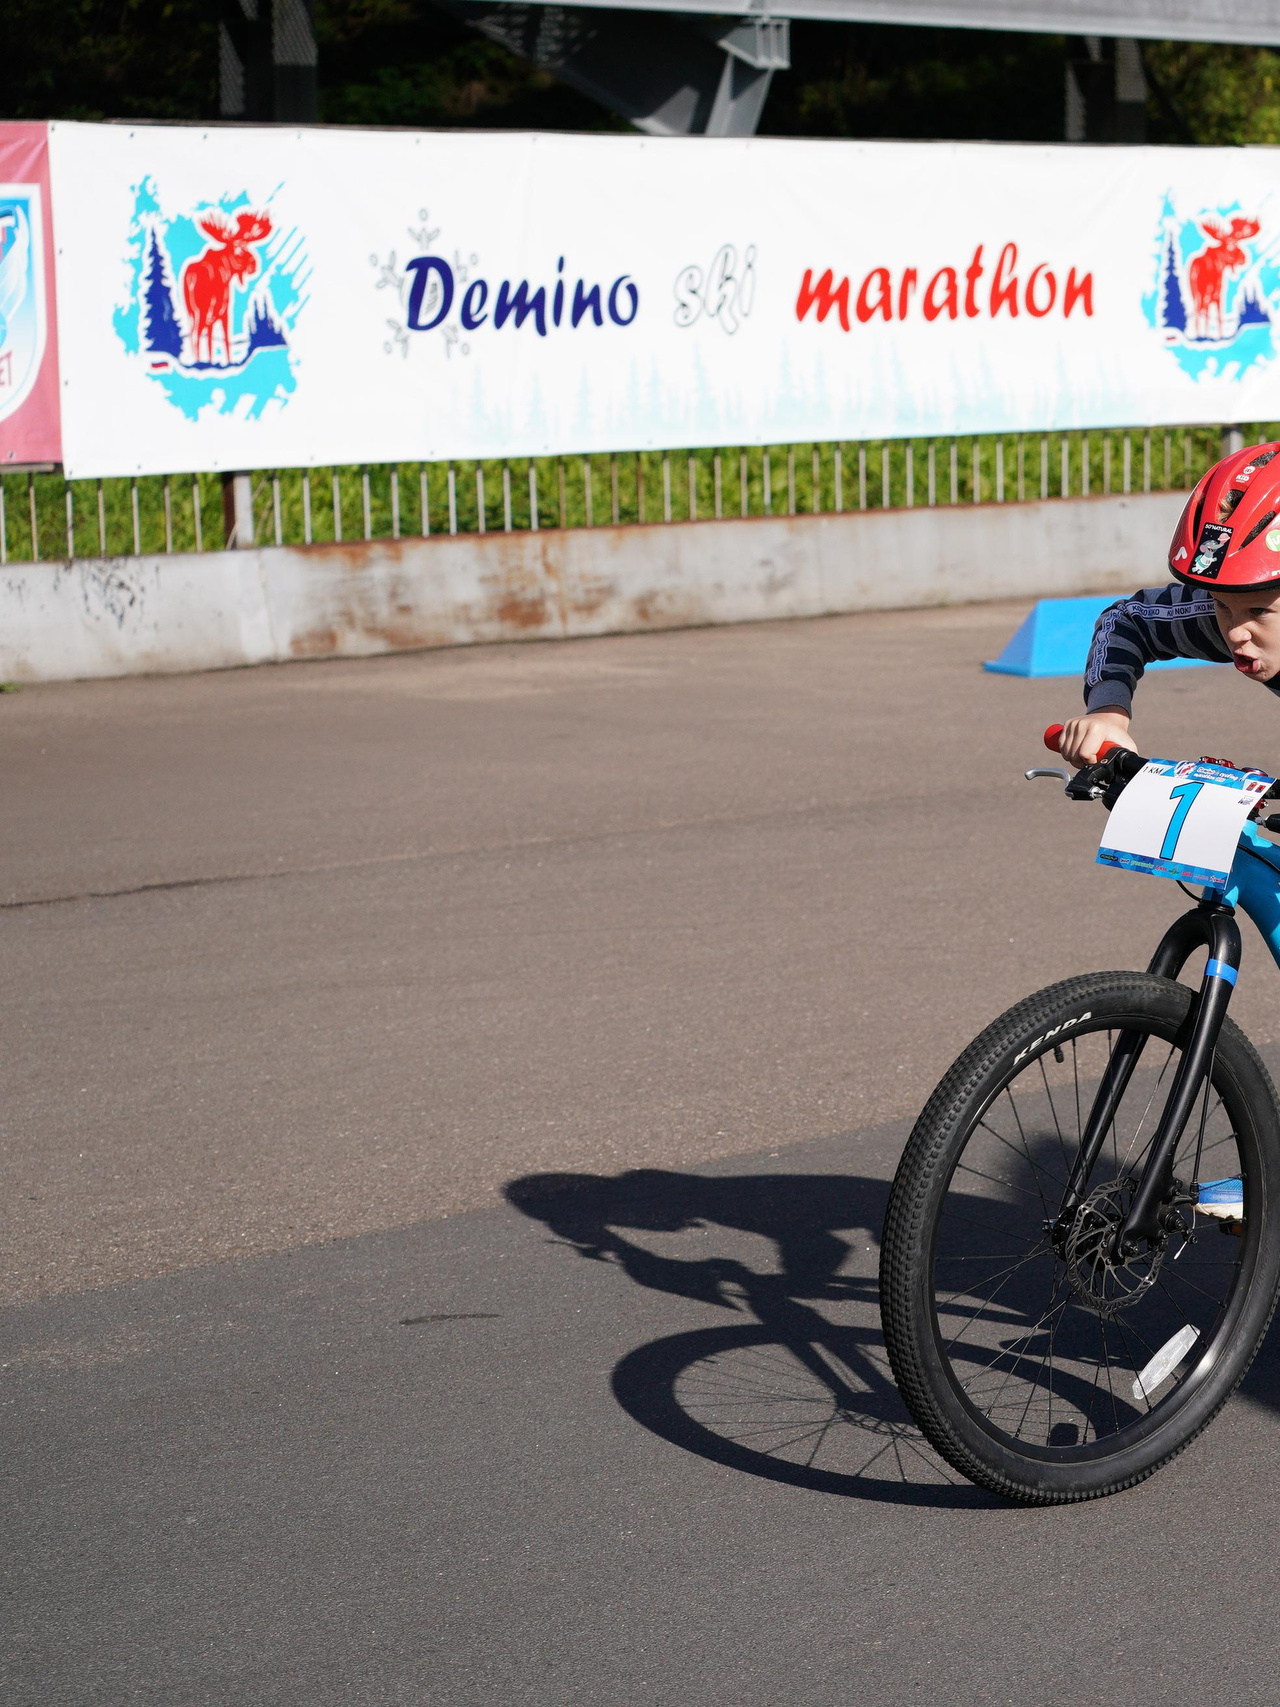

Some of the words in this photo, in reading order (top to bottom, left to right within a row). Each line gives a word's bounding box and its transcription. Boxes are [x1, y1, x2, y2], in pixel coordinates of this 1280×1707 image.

[406, 256, 639, 337] Demino
[673, 243, 757, 336] ski
[795, 242, 1094, 332] marathon
[1159, 781, 1204, 861] 1
[1013, 1011, 1092, 1066] KENDA
